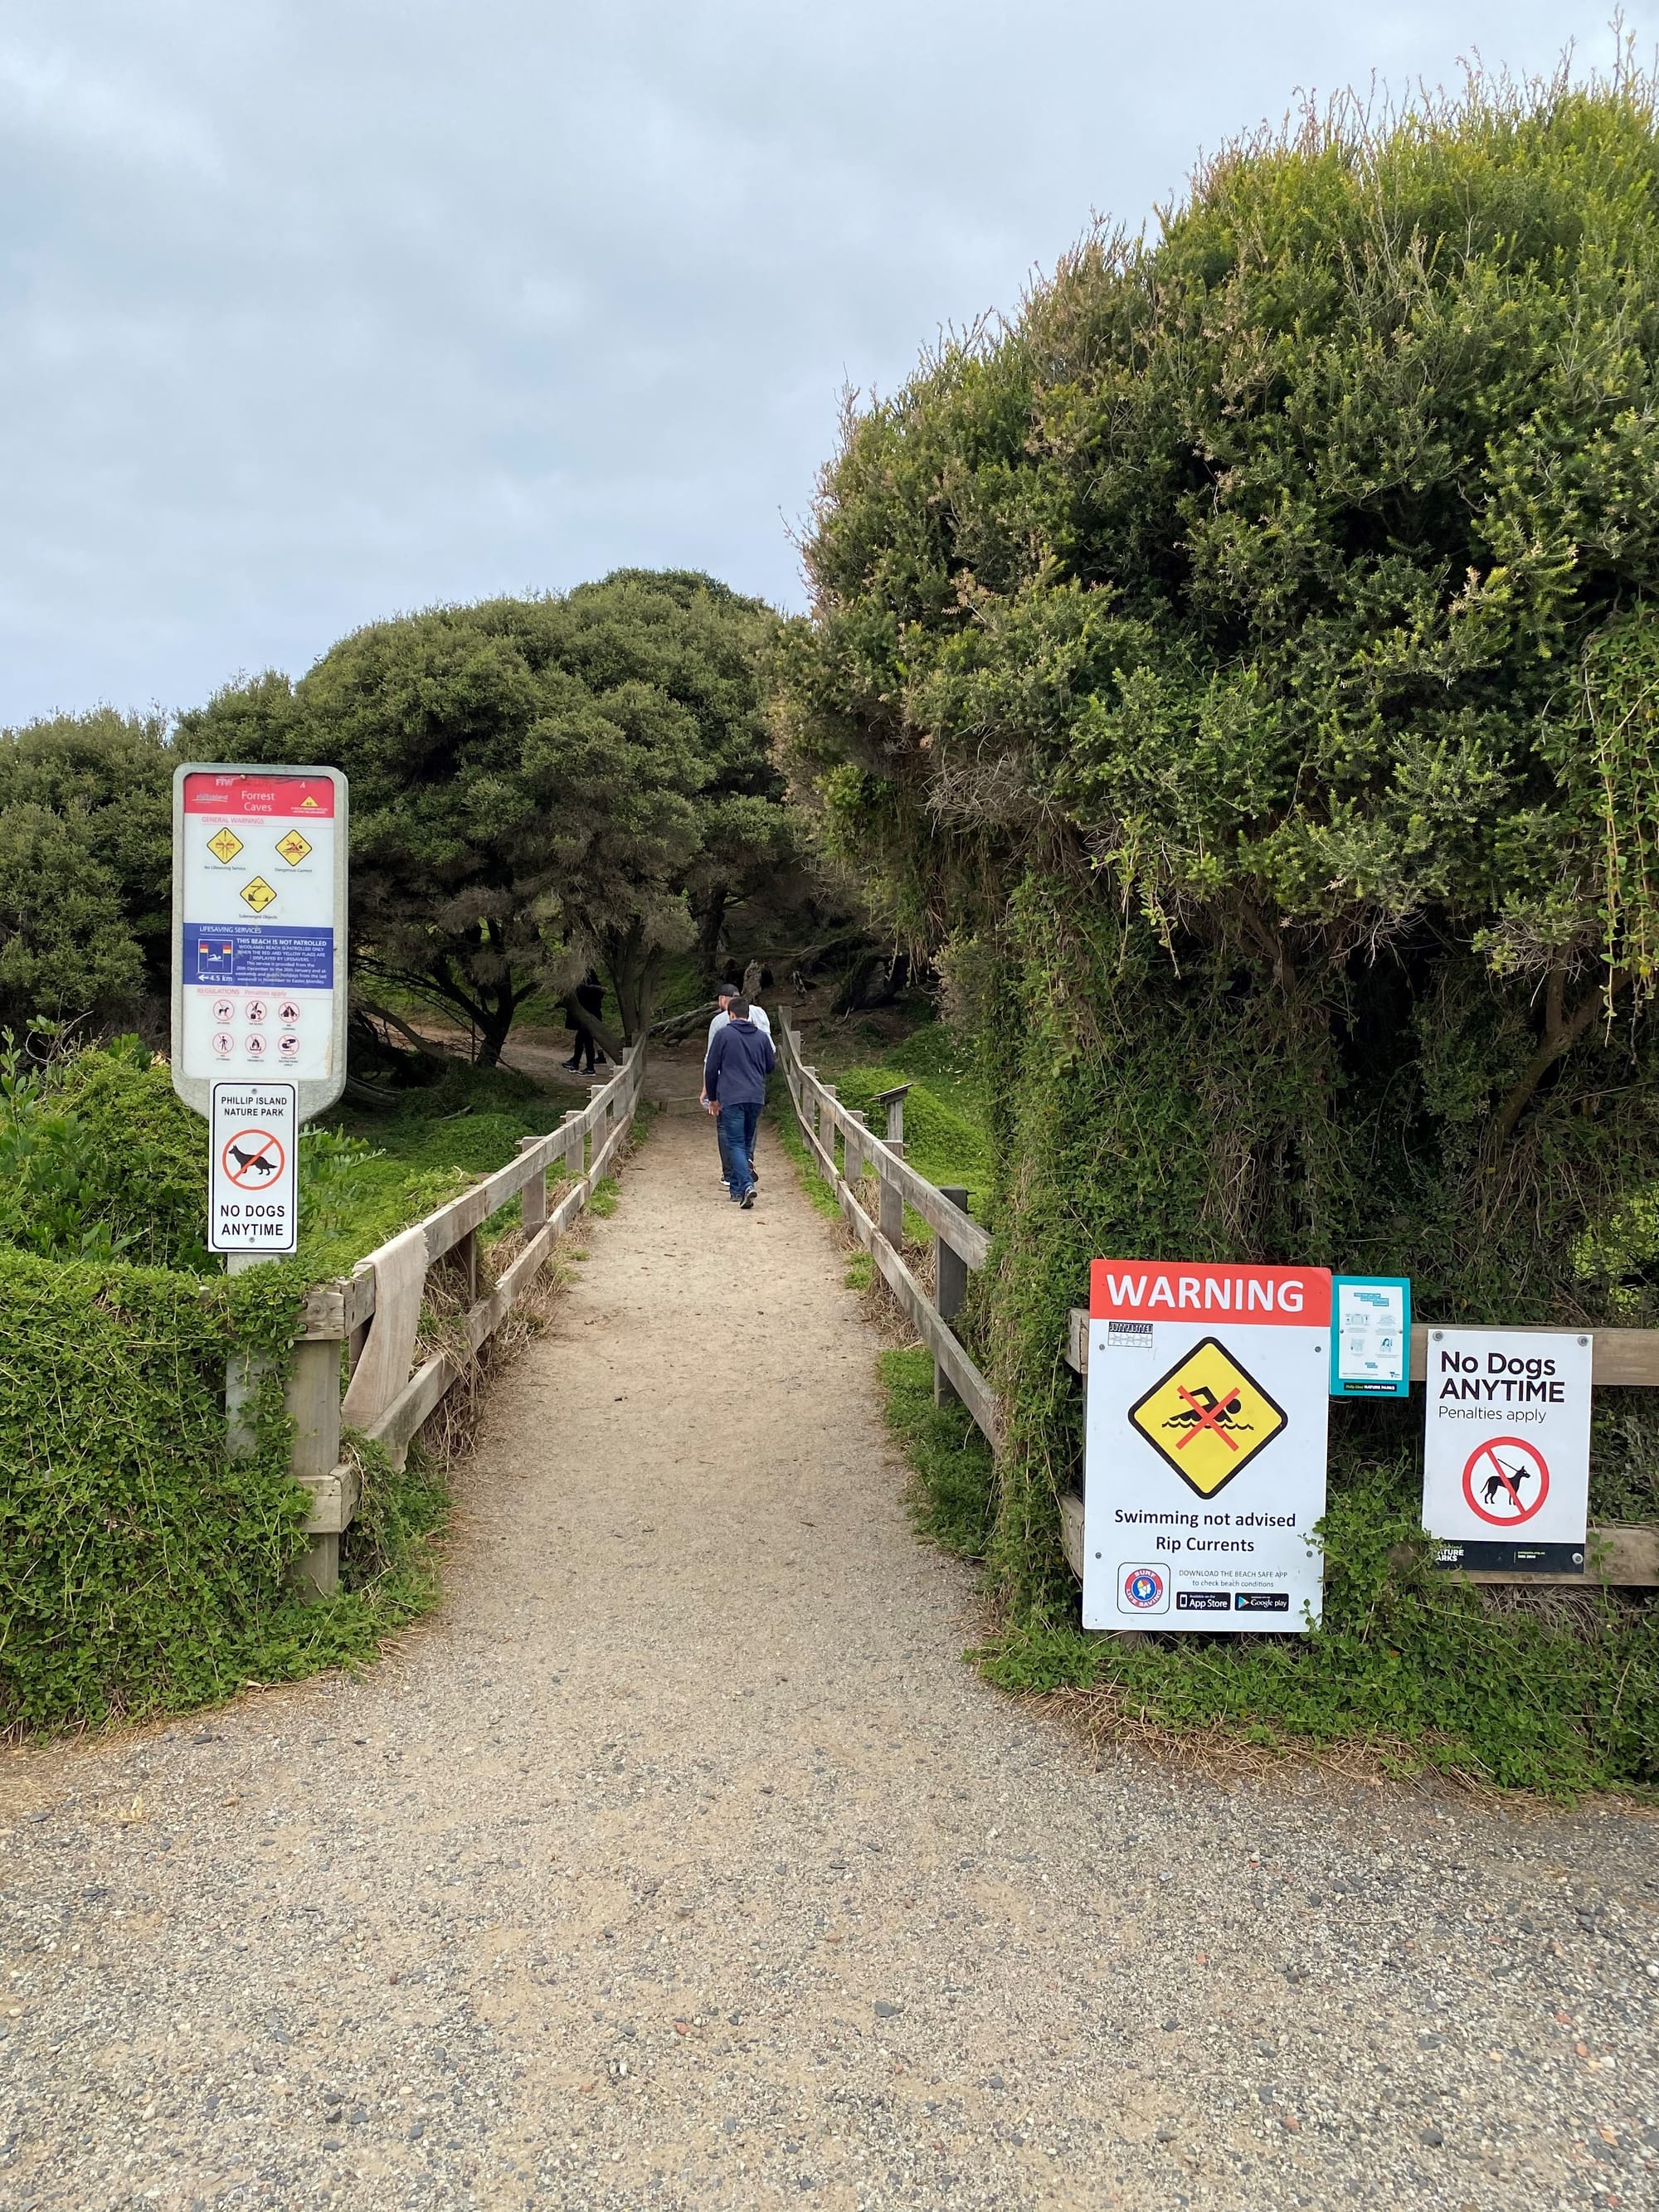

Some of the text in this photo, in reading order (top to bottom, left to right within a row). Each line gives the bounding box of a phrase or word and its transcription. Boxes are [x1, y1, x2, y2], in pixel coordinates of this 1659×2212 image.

[241, 790, 275, 803] Forrest
[244, 802, 272, 813] Caves
[221, 1096, 287, 1106] PHILLIP ISLAND
[224, 1108, 258, 1116] NATURE
[221, 1205, 285, 1218] NO DOGS
[221, 1223, 284, 1236] ANYTIME
[1106, 1274, 1304, 1312] WARNING
[1441, 1351, 1555, 1380] No Dogs
[1439, 1378, 1565, 1403] ANYTIME
[1438, 1405, 1547, 1424] Penalties apply
[1115, 1510, 1296, 1529] Swimming not advised
[1155, 1536, 1254, 1553] Rip Currents
[1134, 1569, 1156, 1578] SURF
[1179, 1569, 1219, 1578] DOWNLOAD
[1126, 1588, 1162, 1607] LIFE SAVING
[1189, 1599, 1228, 1609] App Store
[1250, 1598, 1287, 1610] Google play
